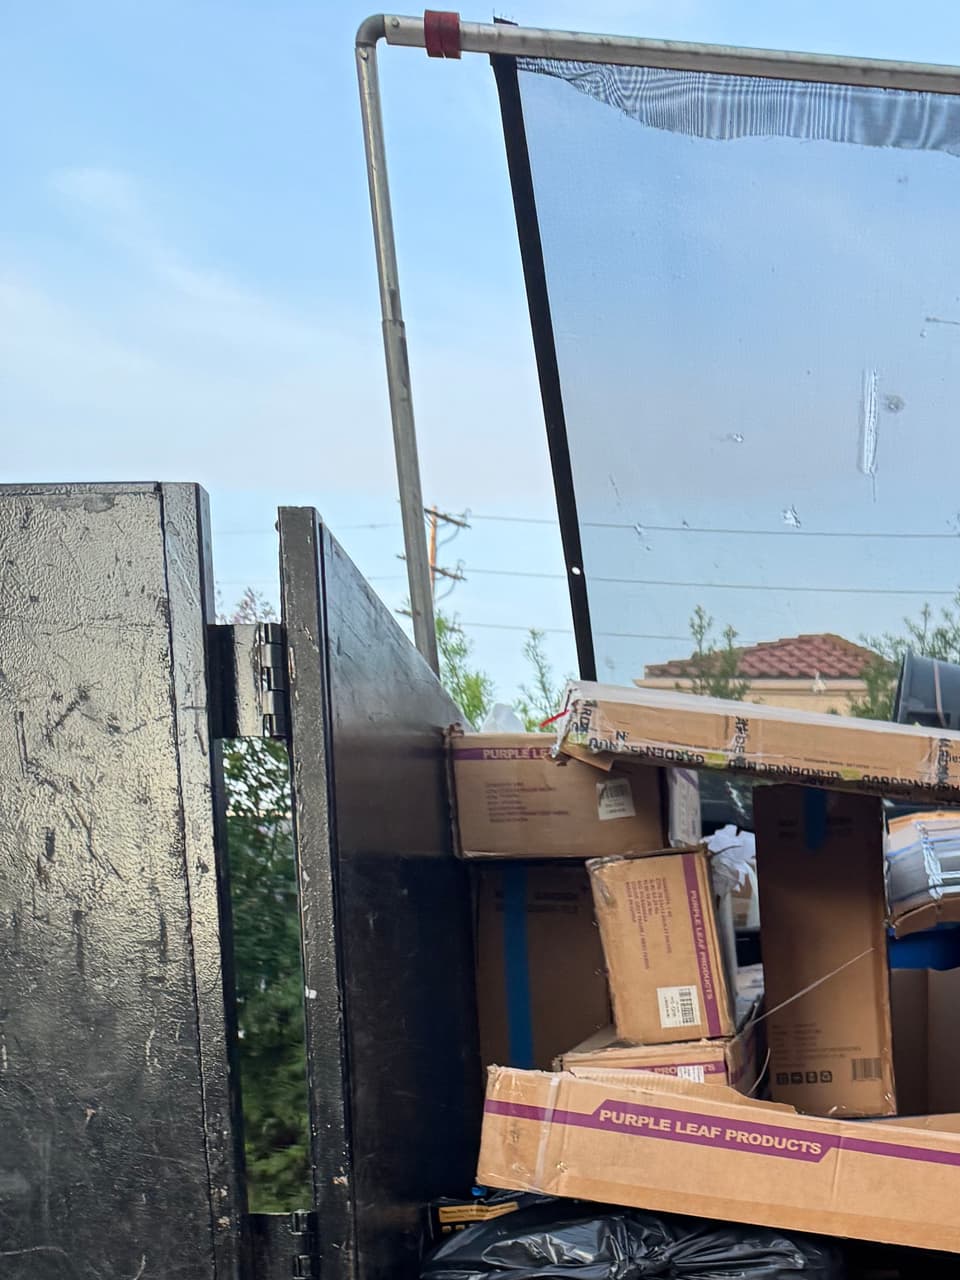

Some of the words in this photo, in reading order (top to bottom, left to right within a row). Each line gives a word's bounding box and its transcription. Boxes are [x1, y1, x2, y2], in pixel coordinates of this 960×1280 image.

[482, 749, 530, 760] PURPLE
[690, 890, 701, 926] PURPLE
[696, 927, 706, 952] LEAF
[599, 1108, 671, 1132] PURPLE
[675, 1119, 721, 1140] LEAF
[726, 1128, 823, 1155] PRODUCTS
